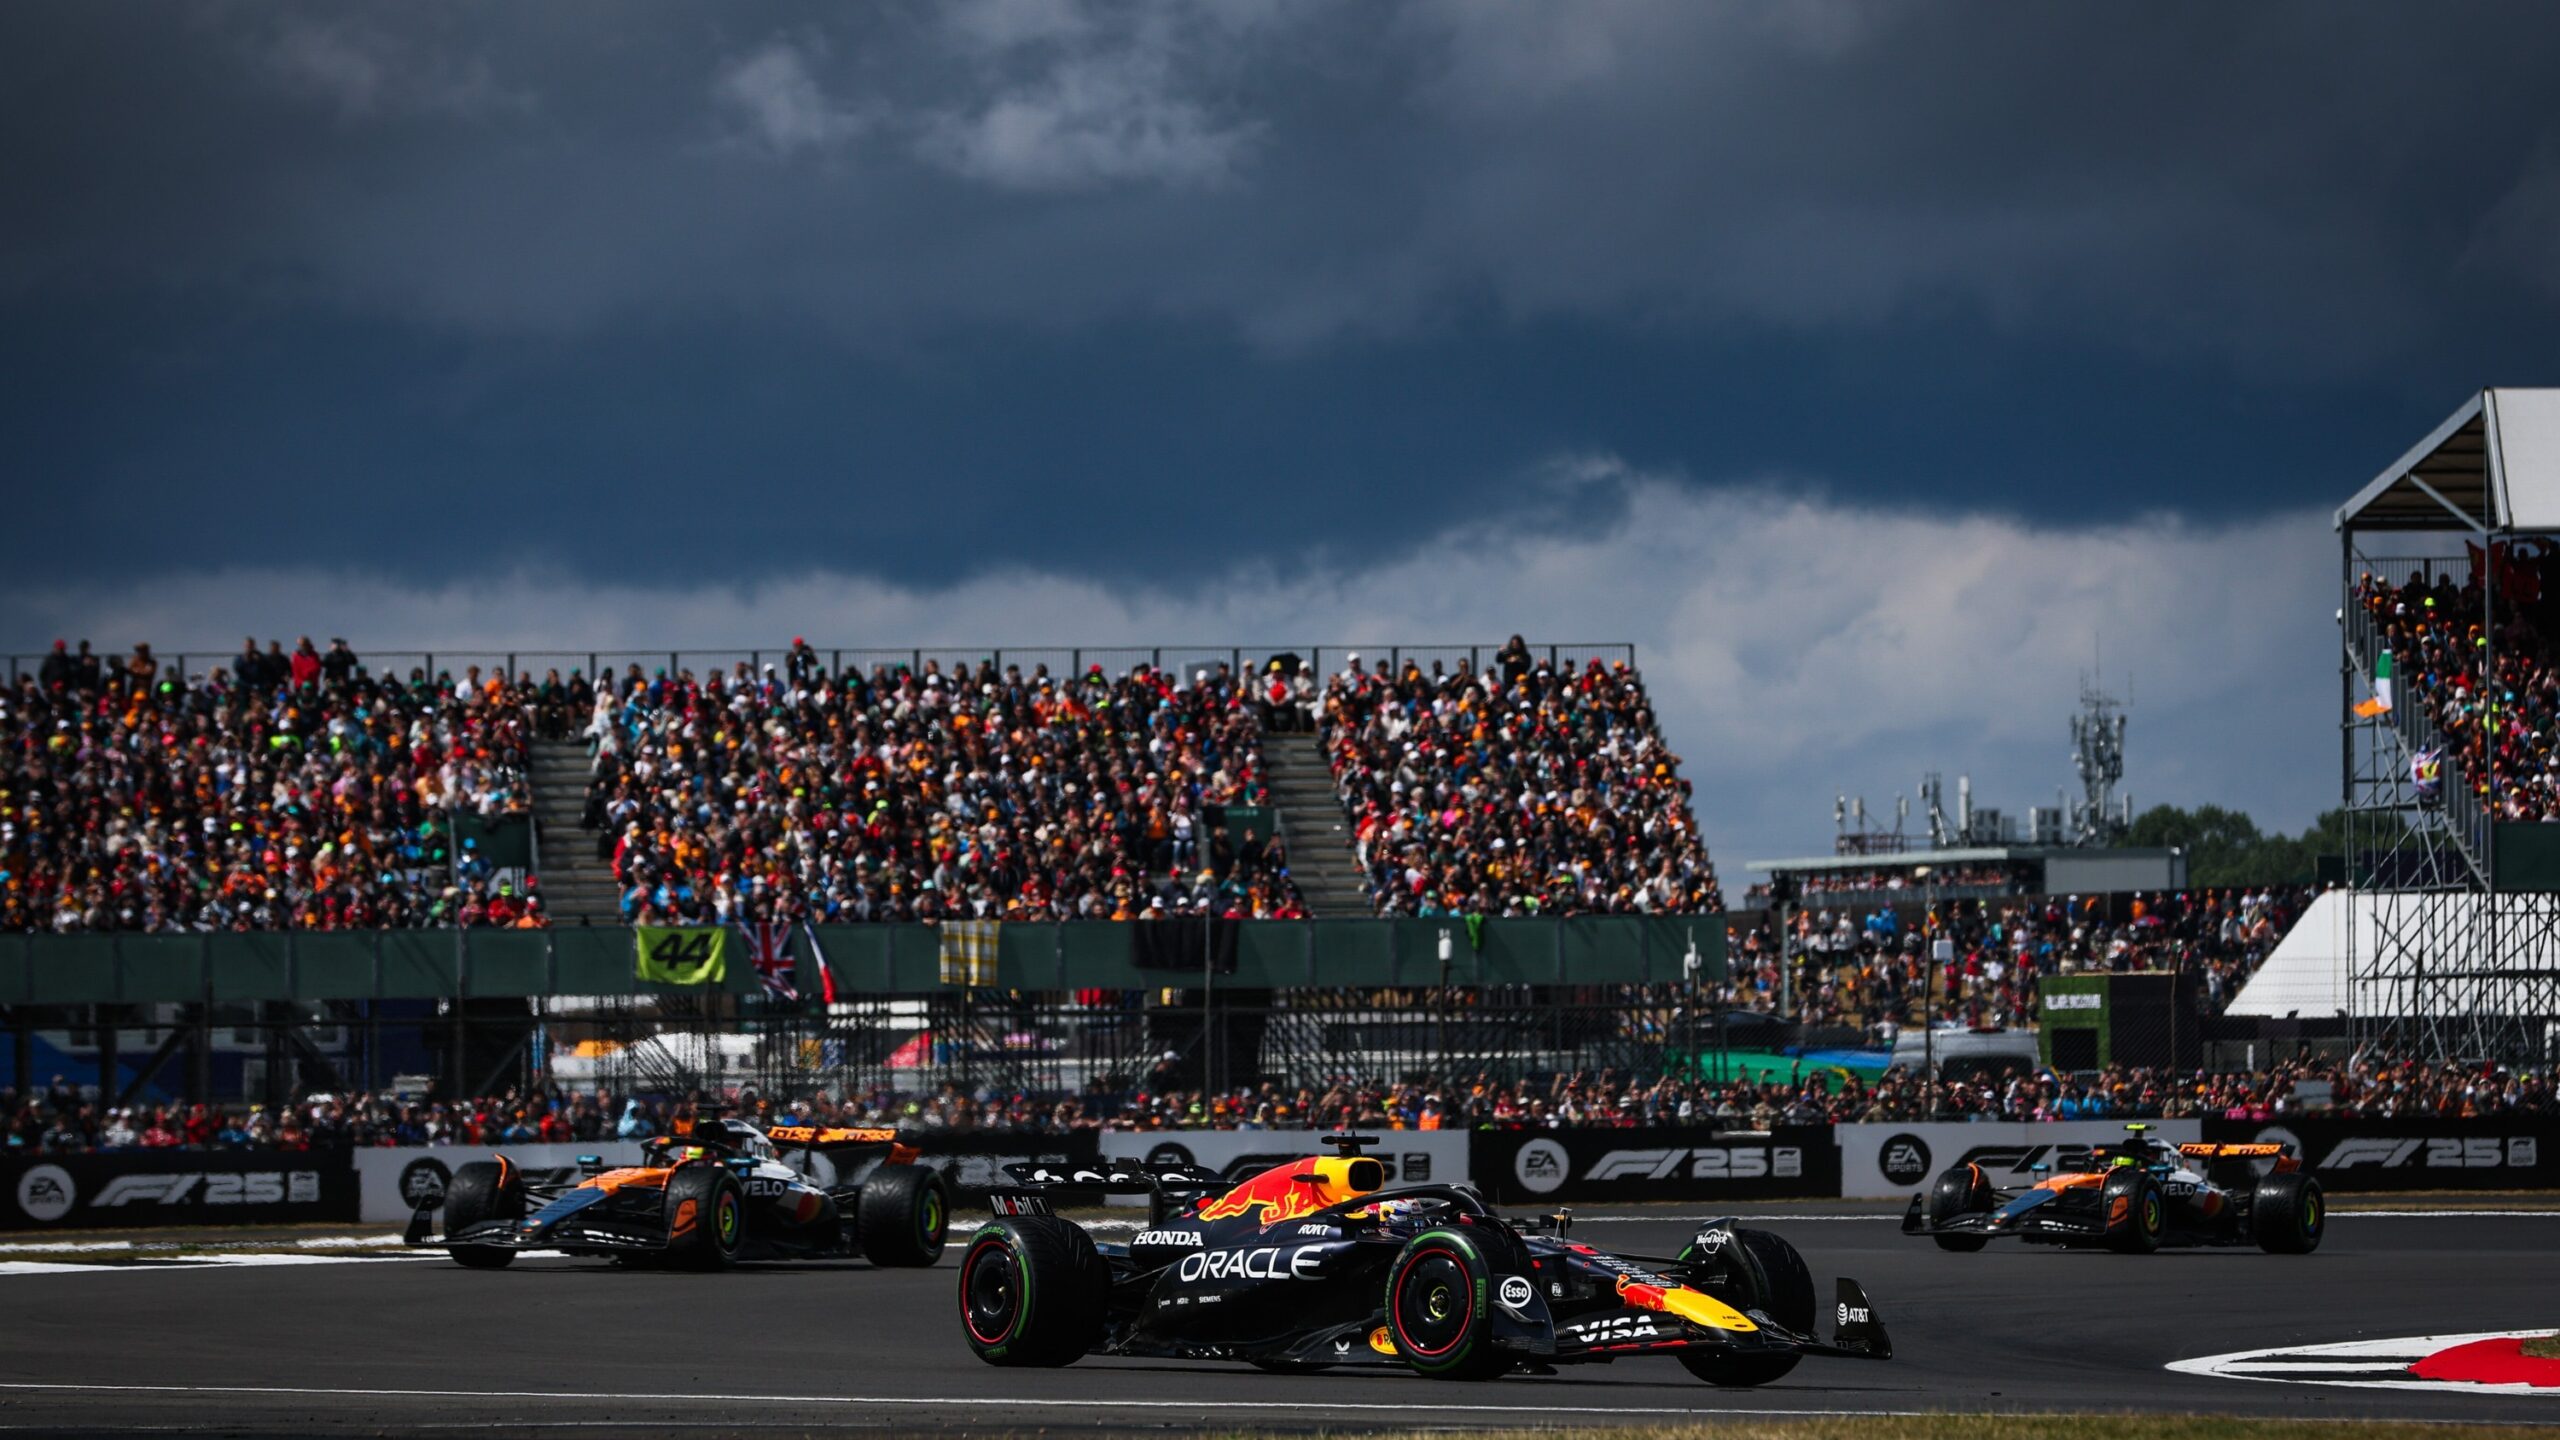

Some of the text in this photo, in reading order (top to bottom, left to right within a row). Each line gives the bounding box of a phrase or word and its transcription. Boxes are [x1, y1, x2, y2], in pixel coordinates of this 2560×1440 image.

[651, 934, 711, 970] 44
[1526, 1150, 1558, 1169] EA
[1887, 1145, 1921, 1163] EA
[2316, 1137, 2425, 1169] F1
[2426, 1137, 2503, 1167] 25
[1524, 1168, 1561, 1178] SPORTS
[1583, 1149, 1690, 1180] F1
[1692, 1147, 1768, 1178] 25
[1887, 1163, 1924, 1173] SPORTS
[88, 1173, 203, 1206] F1
[204, 1171, 285, 1205] 25
[990, 1195, 1036, 1216] Mobil
[1133, 1231, 1204, 1246] HONDA
[1298, 1224, 1328, 1236] ROKT
[1180, 1245, 1327, 1282] ORACLE
[1848, 1307, 1869, 1323] AT&T
[1567, 1315, 1659, 1343] VISA
